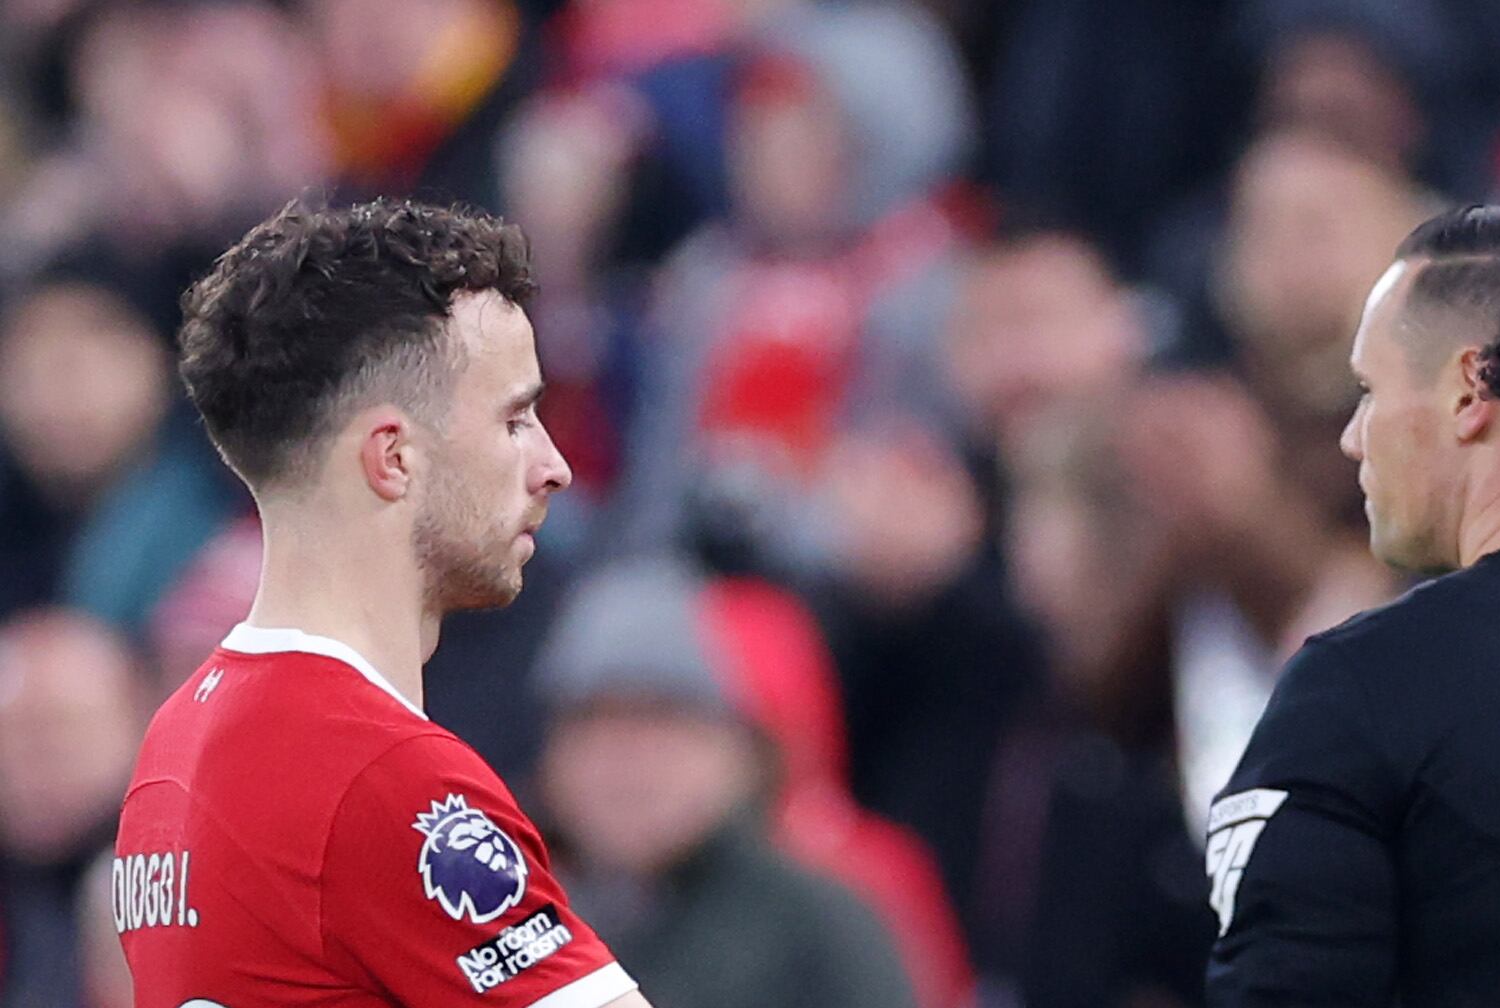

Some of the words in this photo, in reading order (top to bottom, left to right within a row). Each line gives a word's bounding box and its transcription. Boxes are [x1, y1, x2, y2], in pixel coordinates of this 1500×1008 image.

[112, 852, 174, 934] DIOGO
[456, 946, 498, 978] No
[496, 911, 553, 957] room
[470, 962, 506, 994] for
[504, 923, 574, 975] racism
